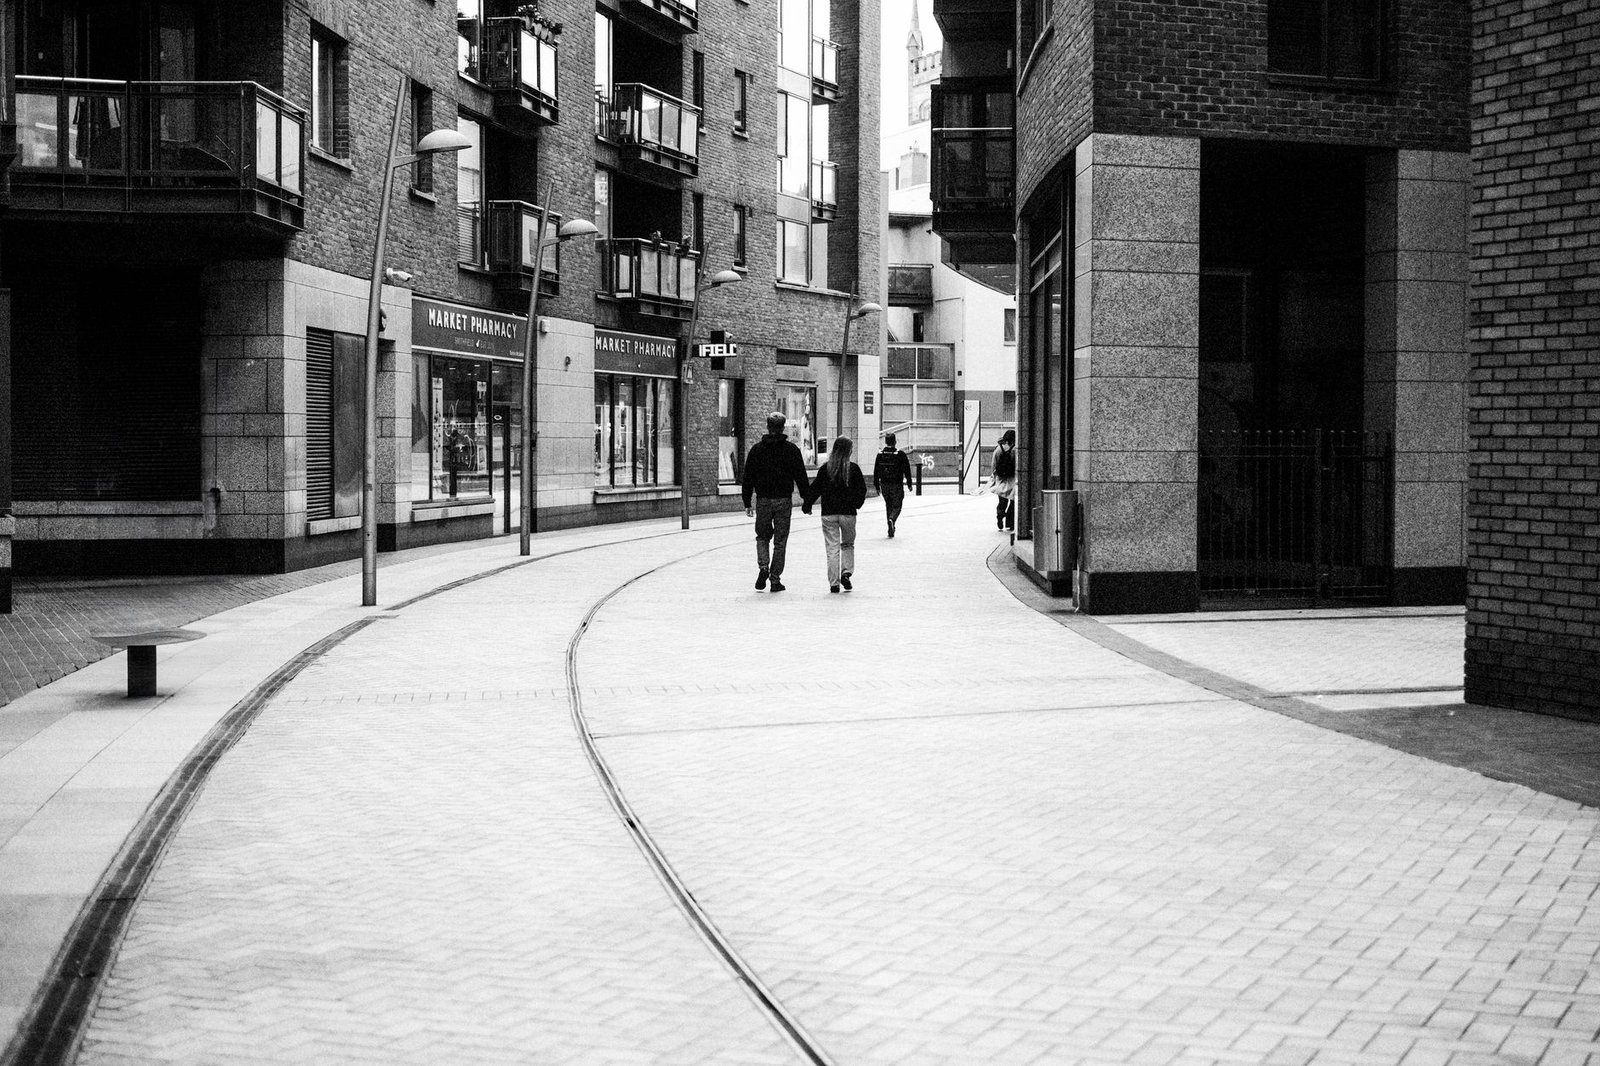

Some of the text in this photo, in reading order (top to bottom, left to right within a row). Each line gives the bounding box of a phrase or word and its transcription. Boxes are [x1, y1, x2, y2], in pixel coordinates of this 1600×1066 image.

[428, 308, 517, 339] MARKET PHARMACY
[595, 336, 676, 358] MARKET PHARMACY
